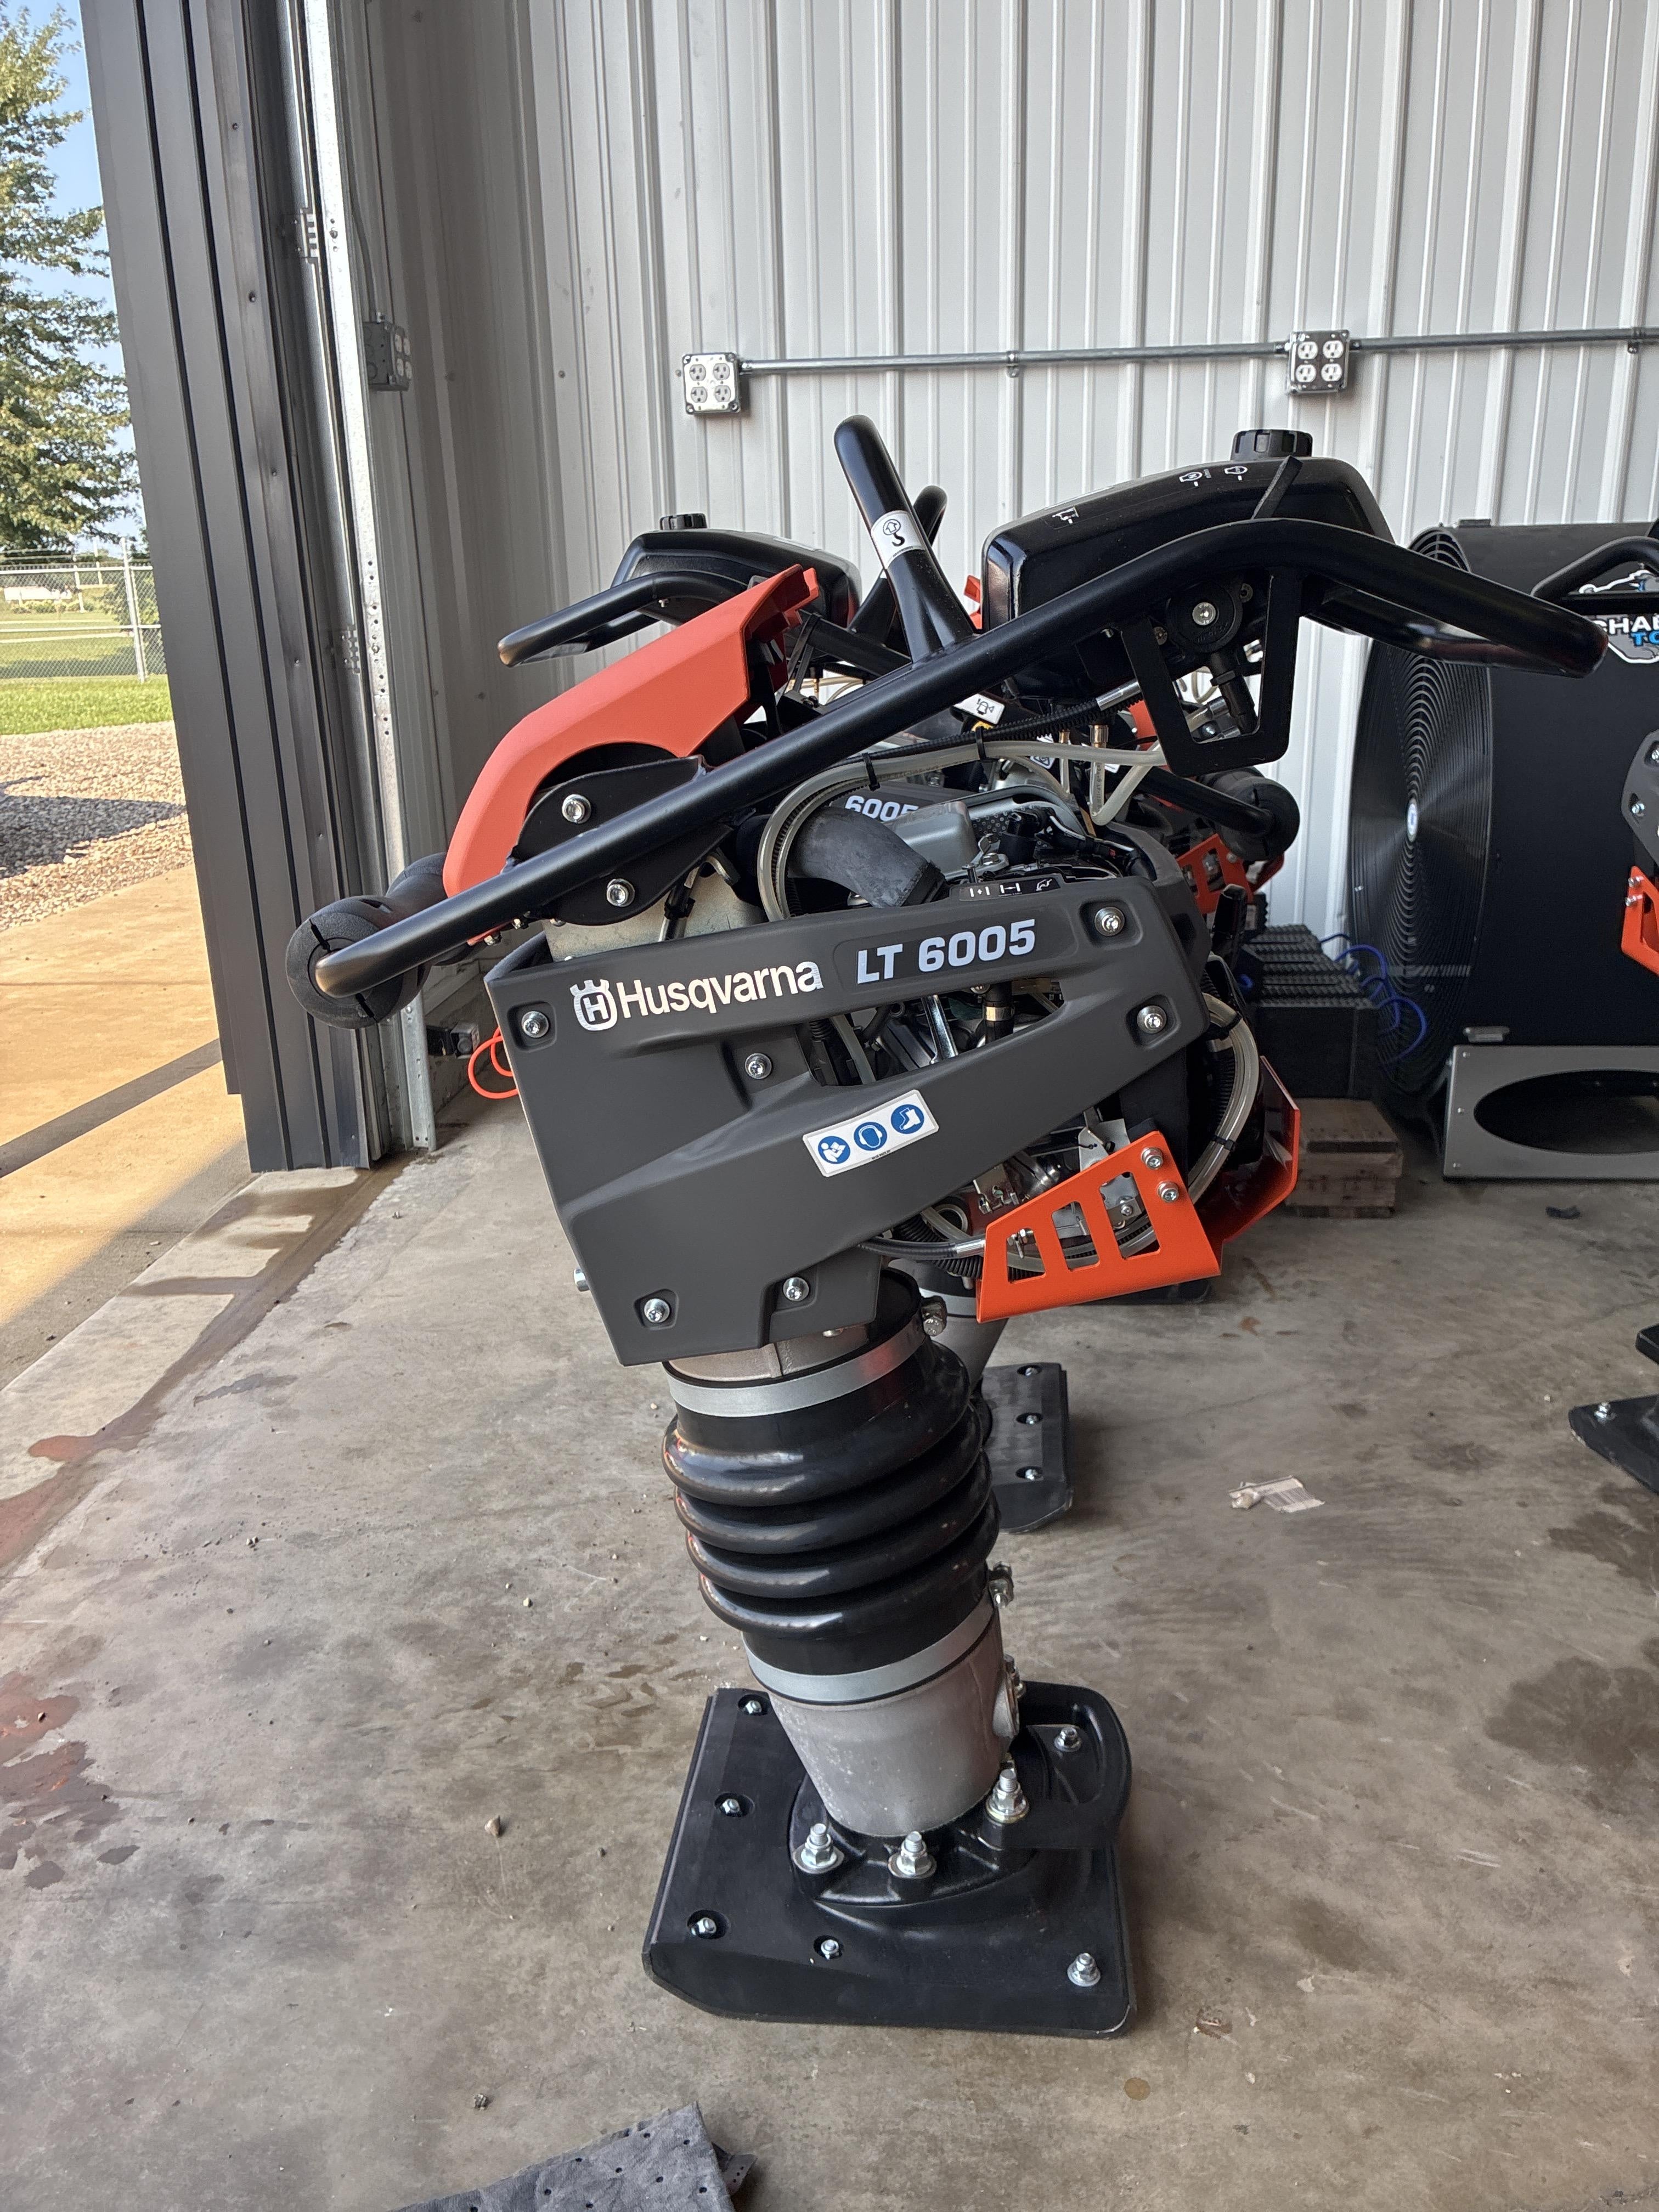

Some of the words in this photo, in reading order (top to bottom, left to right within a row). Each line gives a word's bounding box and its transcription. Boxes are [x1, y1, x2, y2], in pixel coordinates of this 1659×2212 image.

[857, 944, 903, 984] LT
[918, 918, 1036, 972] 6005
[616, 961, 824, 1019] Husqvarna
